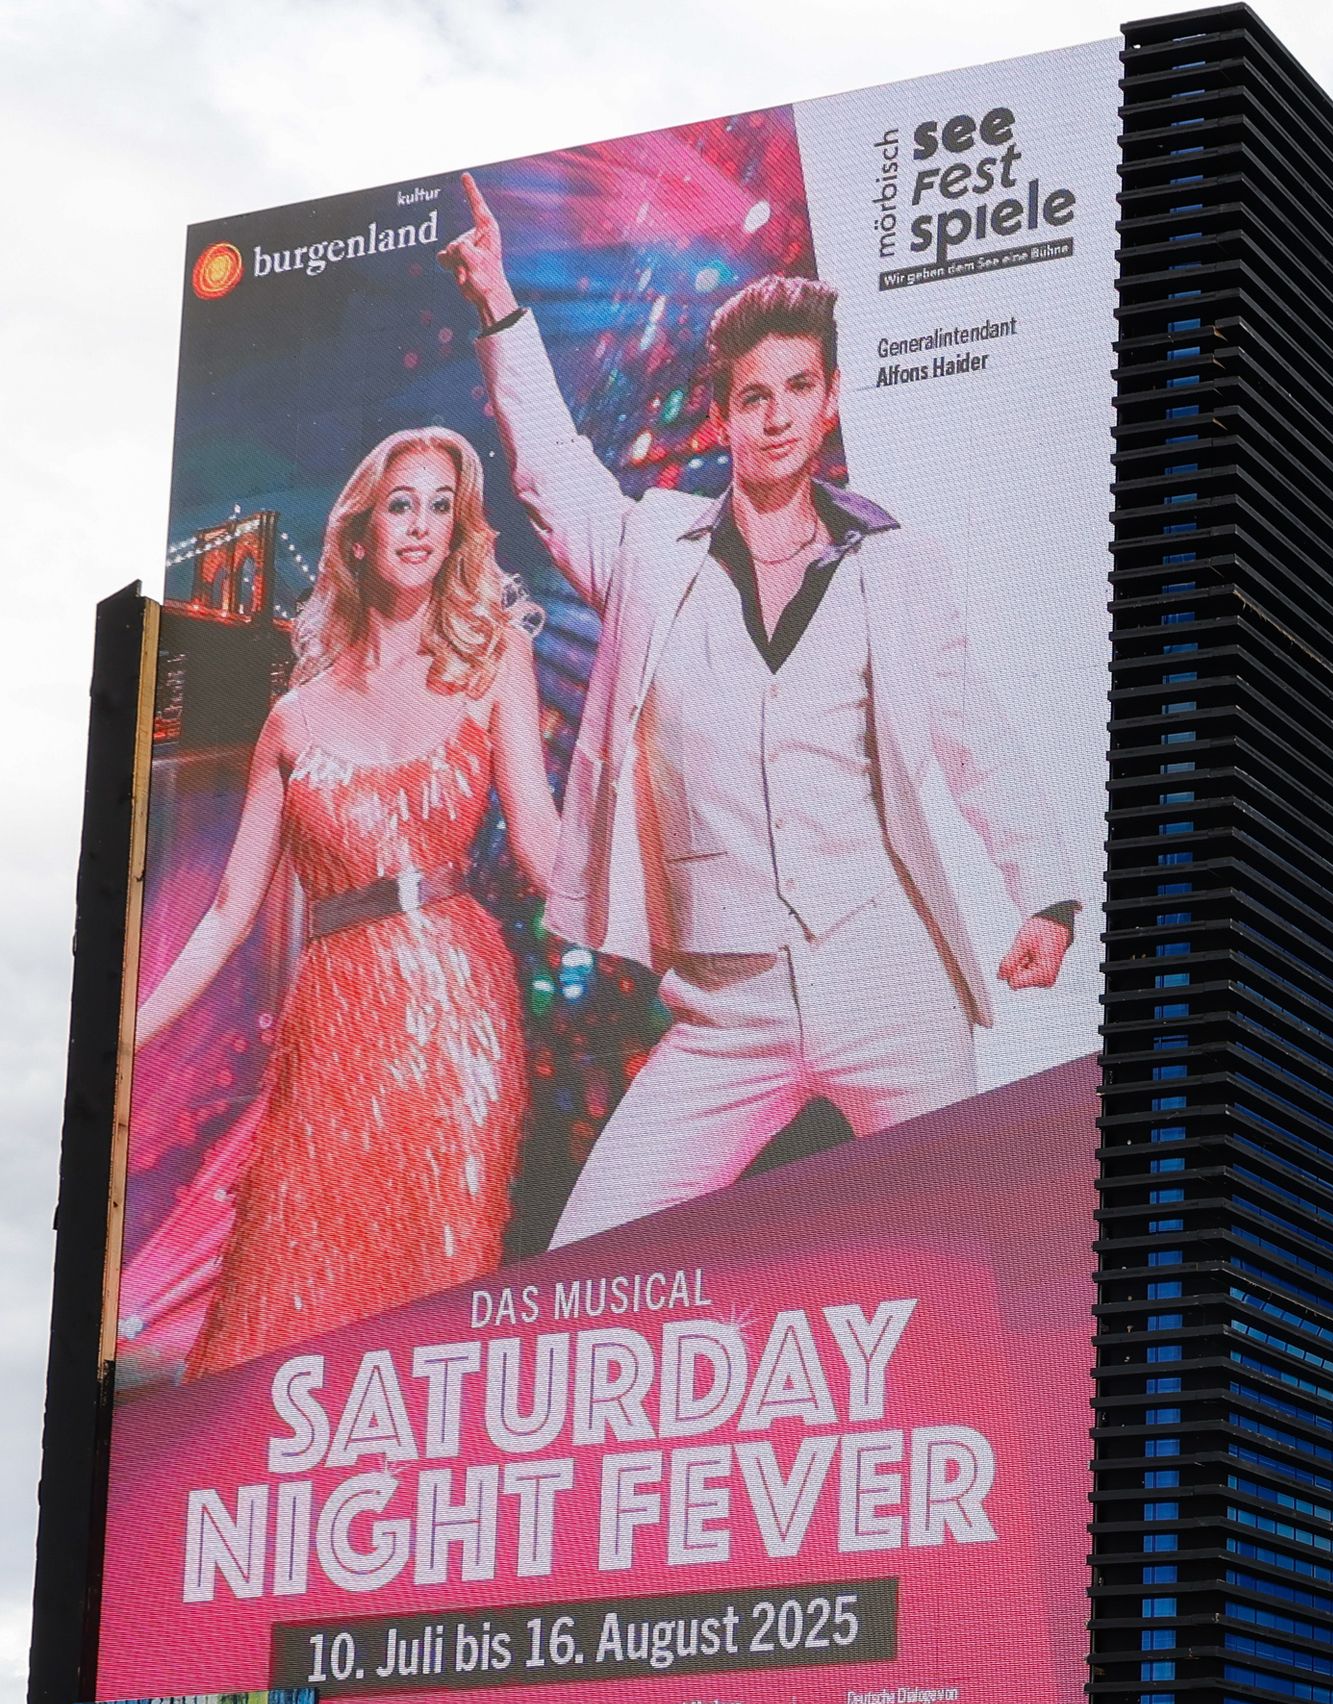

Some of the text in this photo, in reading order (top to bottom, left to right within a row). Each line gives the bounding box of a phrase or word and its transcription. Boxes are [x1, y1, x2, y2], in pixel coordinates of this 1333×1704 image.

[913, 107, 1016, 160] see
[397, 187, 441, 206] kultur
[872, 128, 899, 258] mörbisch
[910, 178, 1076, 263] spiele
[254, 209, 438, 277] burgenland
[884, 243, 1070, 287] Wir geben dem See eine Bühne
[877, 316, 1018, 359] Generalintendant
[876, 353, 990, 388] Alfons Haider
[468, 1268, 714, 1330] DAS MUSICAL
[268, 1297, 920, 1474] SATURDAY
[182, 1424, 998, 1603] NIGHT FEVER
[306, 1594, 860, 1684] 10. Juli bis 16. August 2025
[938, 1687, 958, 1701] von
